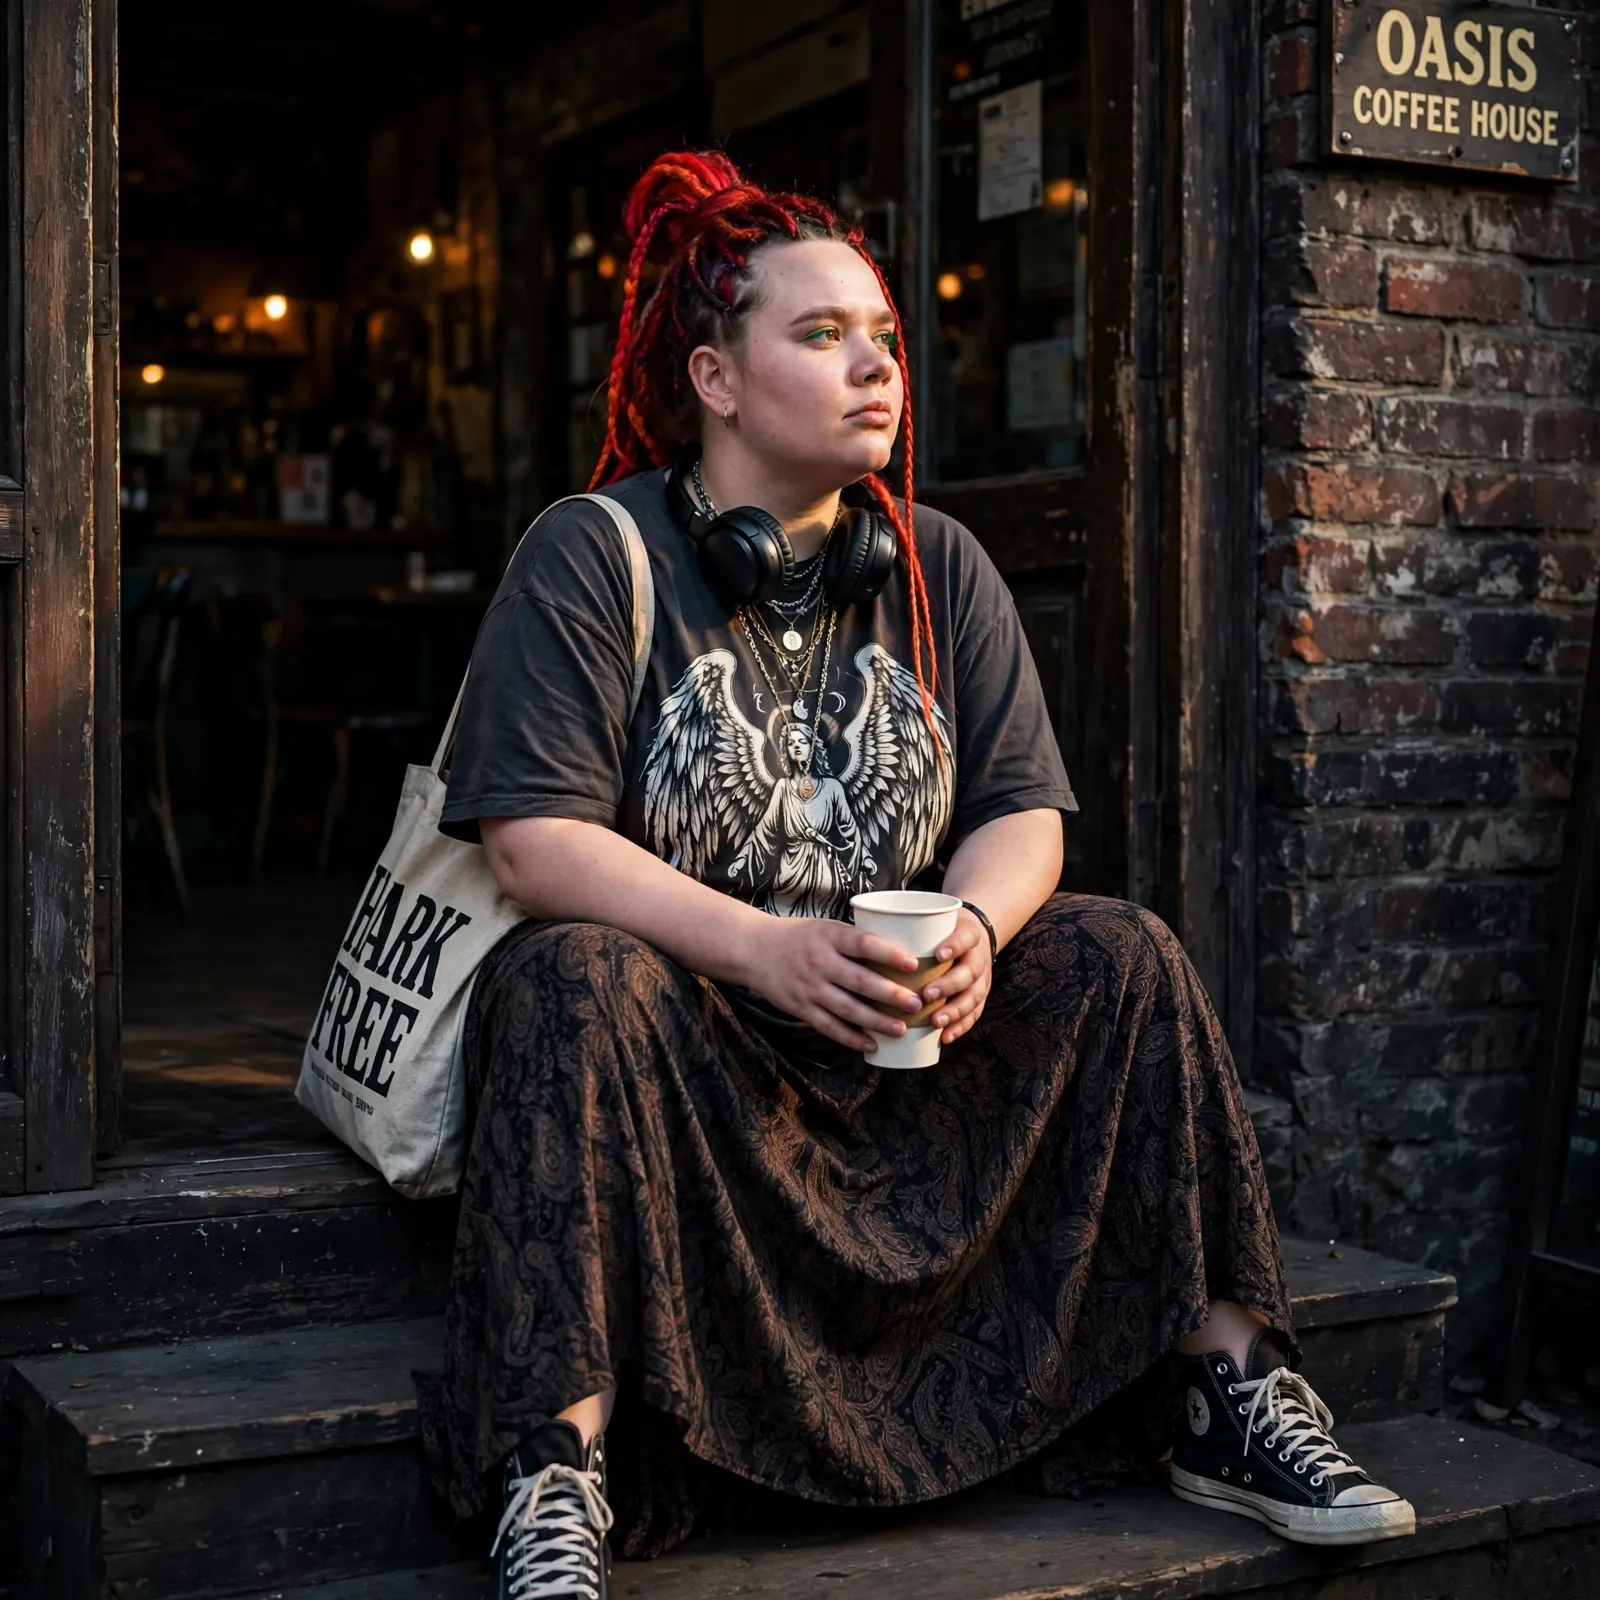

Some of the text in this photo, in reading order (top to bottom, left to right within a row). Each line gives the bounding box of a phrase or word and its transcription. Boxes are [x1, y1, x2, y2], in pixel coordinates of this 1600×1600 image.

[1376, 9, 1537, 92] OASIS
[1353, 85, 1559, 146] COFFEE HOUSE
[342, 864, 472, 1000] HARK
[311, 960, 420, 1098] FREE
